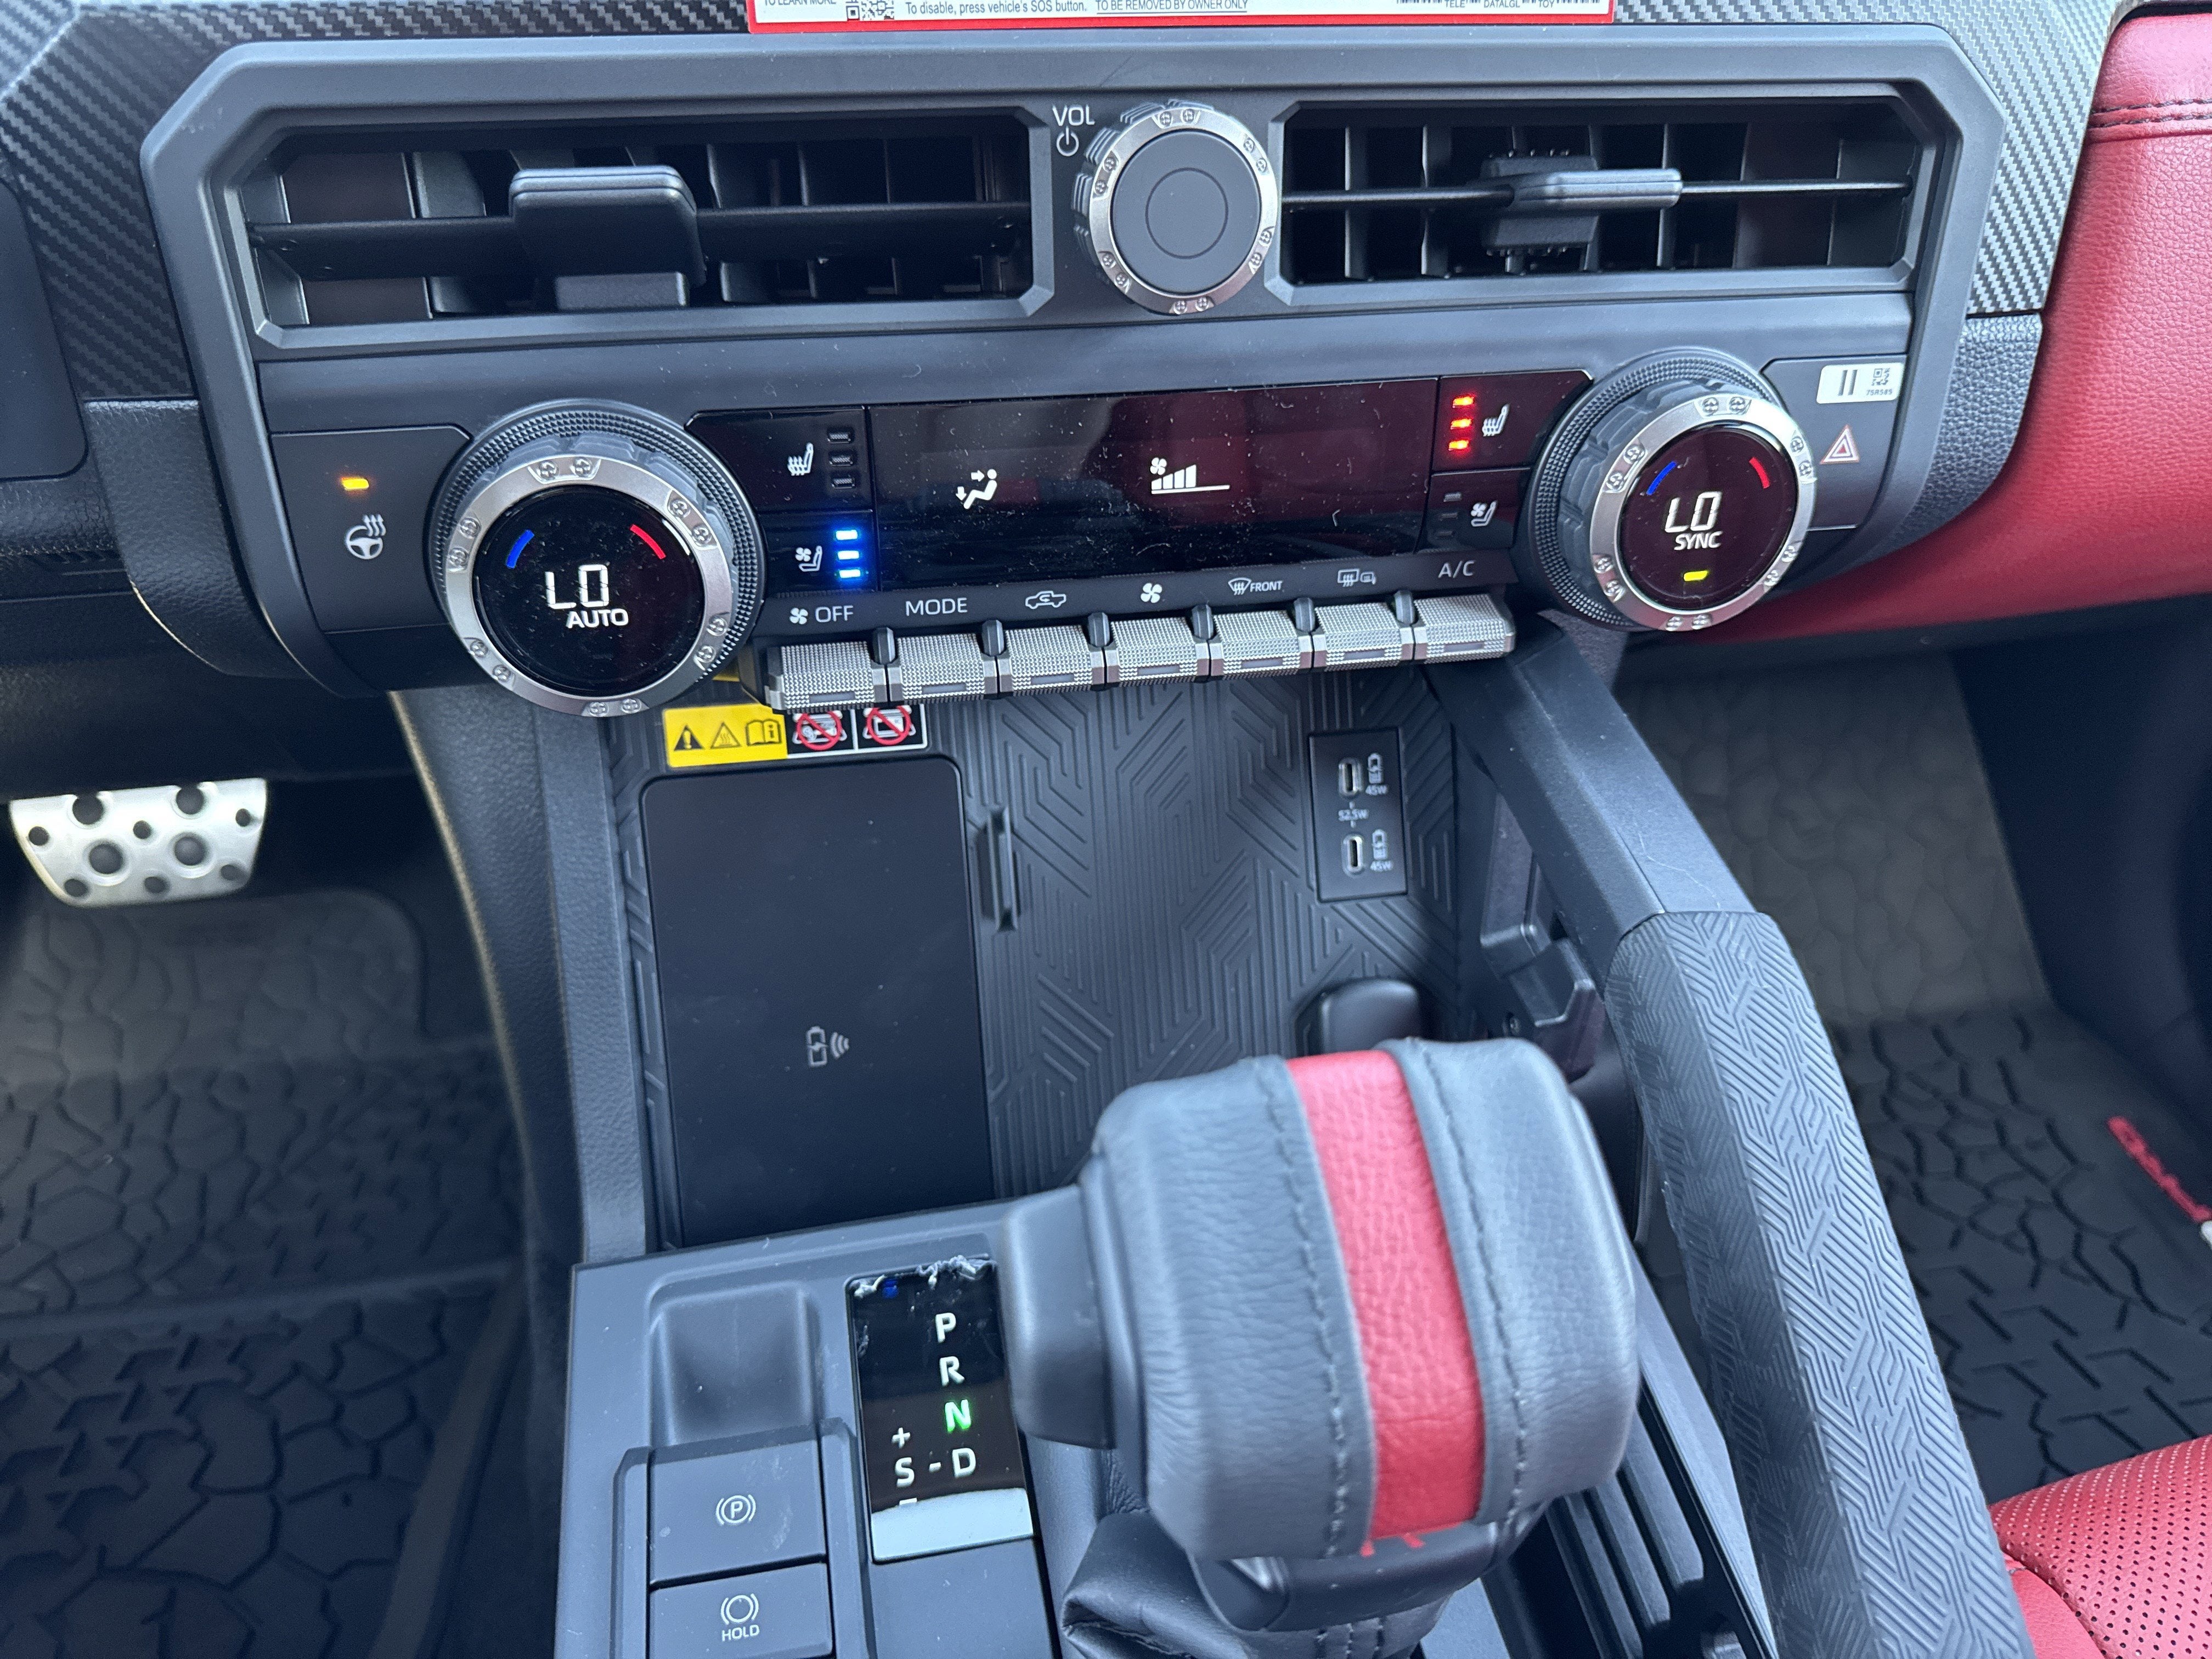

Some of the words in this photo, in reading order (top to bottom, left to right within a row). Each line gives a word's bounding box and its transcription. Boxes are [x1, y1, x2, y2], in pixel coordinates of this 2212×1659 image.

[905, 2, 917, 14] To
[920, 1, 956, 15] disable,
[960, 3, 985, 16] press
[988, 0, 1028, 13] vehicle's
[1031, 0, 1052, 12] SOS
[1056, 0, 1087, 12] button.
[1096, 0, 1108, 10] TO
[1111, 0, 1122, 10] BE
[1126, 0, 1171, 10] REMOVED
[1174, 0, 1184, 9] BY
[1188, 0, 1222, 9] OWNER
[1225, 0, 1248, 9] ONLY
[1053, 105, 1095, 127] VOL
[1664, 491, 1722, 533] LO
[1674, 531, 1722, 550] SYNC
[1438, 560, 1475, 579] A/C
[545, 564, 610, 610] LO
[1250, 580, 1283, 592] FRONT
[815, 605, 854, 623] OFF
[905, 597, 969, 616] MODE
[566, 608, 629, 629] AUTO
[935, 1312, 957, 1343] P
[939, 1356, 965, 1386] R
[944, 1400, 972, 1433] N
[895, 1457, 915, 1487] S
[952, 1447, 977, 1478] D
[721, 1624, 760, 1642] HOLD
